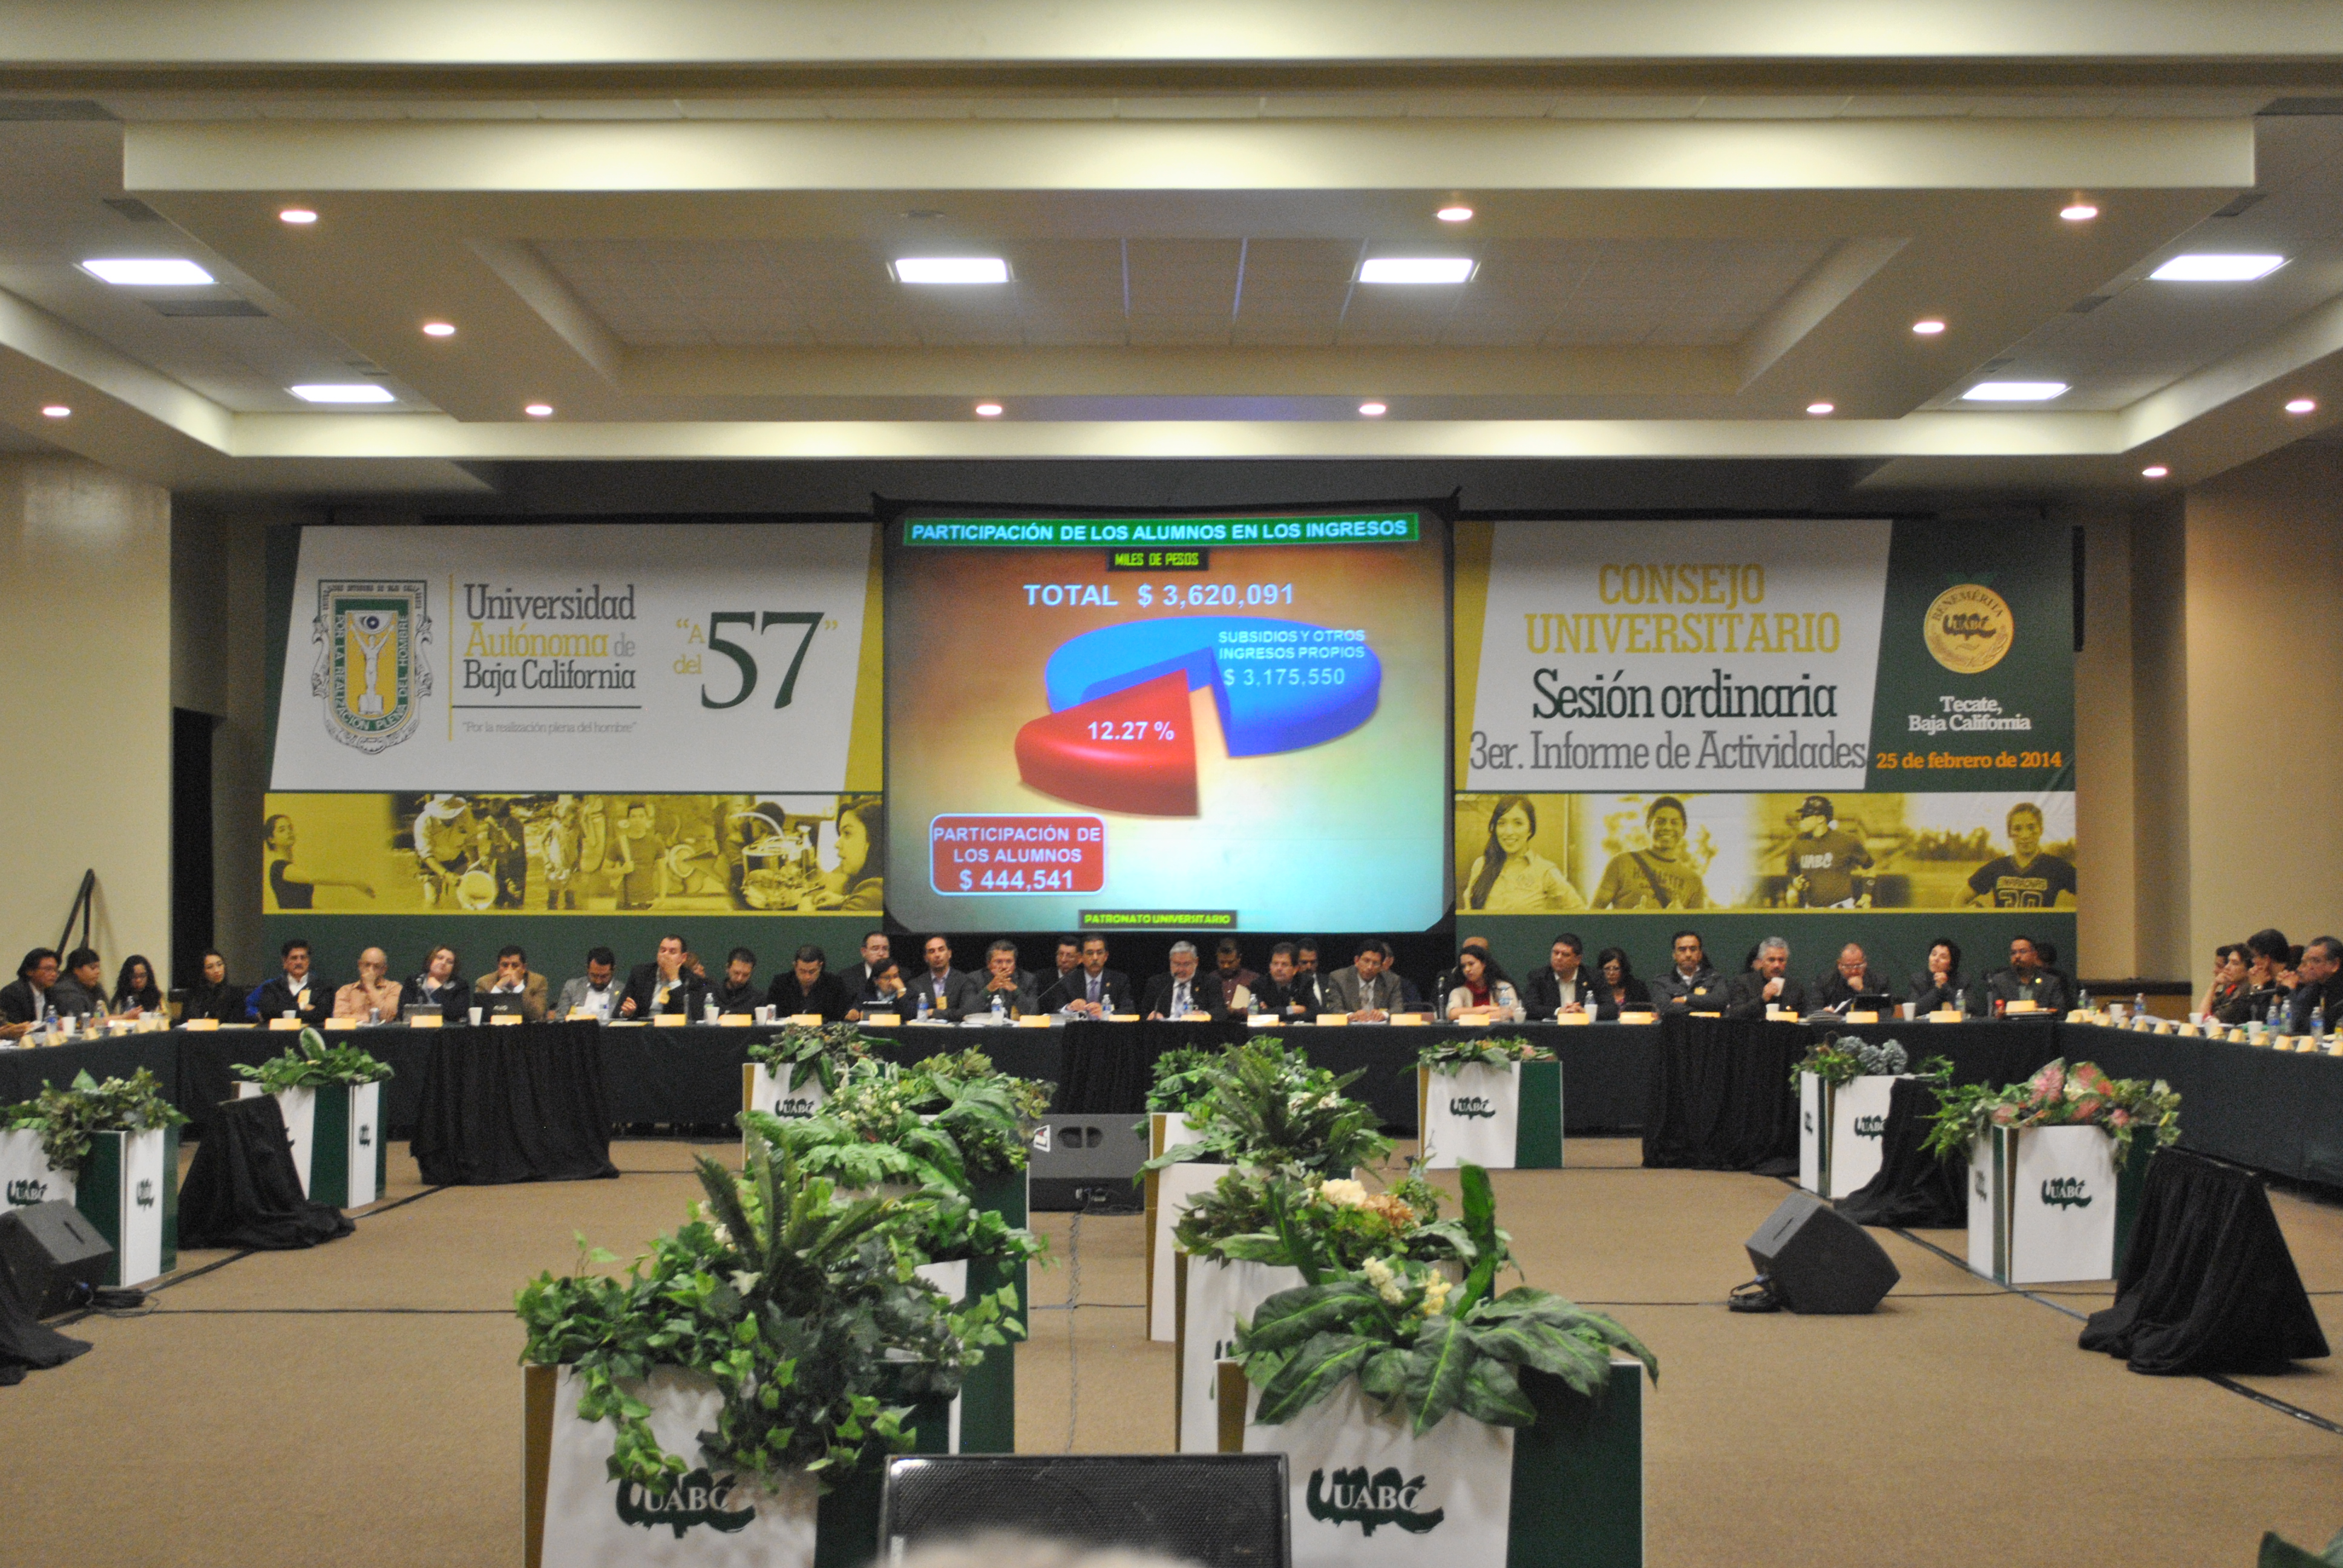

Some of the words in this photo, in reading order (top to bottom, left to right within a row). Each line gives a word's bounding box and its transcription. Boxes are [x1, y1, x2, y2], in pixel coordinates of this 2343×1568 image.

[911, 523, 1053, 540] PARTICIPACIÓN
[1060, 525, 1086, 540] DE
[1090, 525, 1129, 540] LOS
[1133, 524, 1226, 540] ALUMNOS
[1231, 524, 1258, 538] EN
[1263, 523, 1301, 538] LOS
[1306, 520, 1407, 537] INGRESOS
[1115, 553, 1144, 566] MILES
[1149, 553, 1162, 566] DE
[1165, 552, 1199, 566] PESOS
[1023, 584, 1118, 606] TOTAL
[1138, 583, 1152, 608] $
[1162, 583, 1294, 609] 3,620,091
[1597, 562, 1765, 610] CONSEJO
[463, 583, 636, 620] Universidad
[464, 621, 609, 658] Autónoma
[613, 632, 636, 658] de
[1218, 631, 1297, 644] SUBSIDIOS
[1300, 630, 1310, 642] Y
[1312, 630, 1366, 642] OTROS
[1524, 611, 1841, 654] UNIVERSITARIO
[1219, 647, 1295, 659] INGRESOS
[1298, 646, 1365, 659] PROPIOS
[672, 654, 703, 675] del
[463, 659, 517, 697] Baja
[522, 659, 637, 690] California
[1224, 668, 1235, 686] $
[1243, 667, 1345, 687] 3,175,550
[1532, 667, 1655, 719] Sesión
[1660, 667, 1837, 718] ordinaria
[1939, 696, 2003, 714] Tecate,
[1088, 720, 1149, 740] 12.27
[1153, 720, 1175, 740] %
[1908, 715, 1947, 735] Baja
[1948, 713, 2032, 731] California
[1469, 730, 1524, 770] 3er.
[1530, 730, 1650, 769] Informe
[1655, 730, 1691, 769] de
[1698, 730, 1867, 770] Actividades
[1876, 753, 1898, 769] 25
[1901, 752, 1924, 769] de
[1927, 752, 1993, 768] febrero
[1995, 751, 2017, 768] de
[2019, 751, 2063, 768] 2014
[933, 825, 1070, 841] PARTICIPACIÓN
[1076, 827, 1101, 841] DE
[953, 849, 989, 863] LOS
[994, 848, 1082, 863] ALUMNOS
[959, 868, 973, 892] $
[980, 869, 1073, 892] 444,541
[1084, 914, 1150, 924] PATRONATO
[1152, 914, 1231, 924] UNIVERSITARIO
